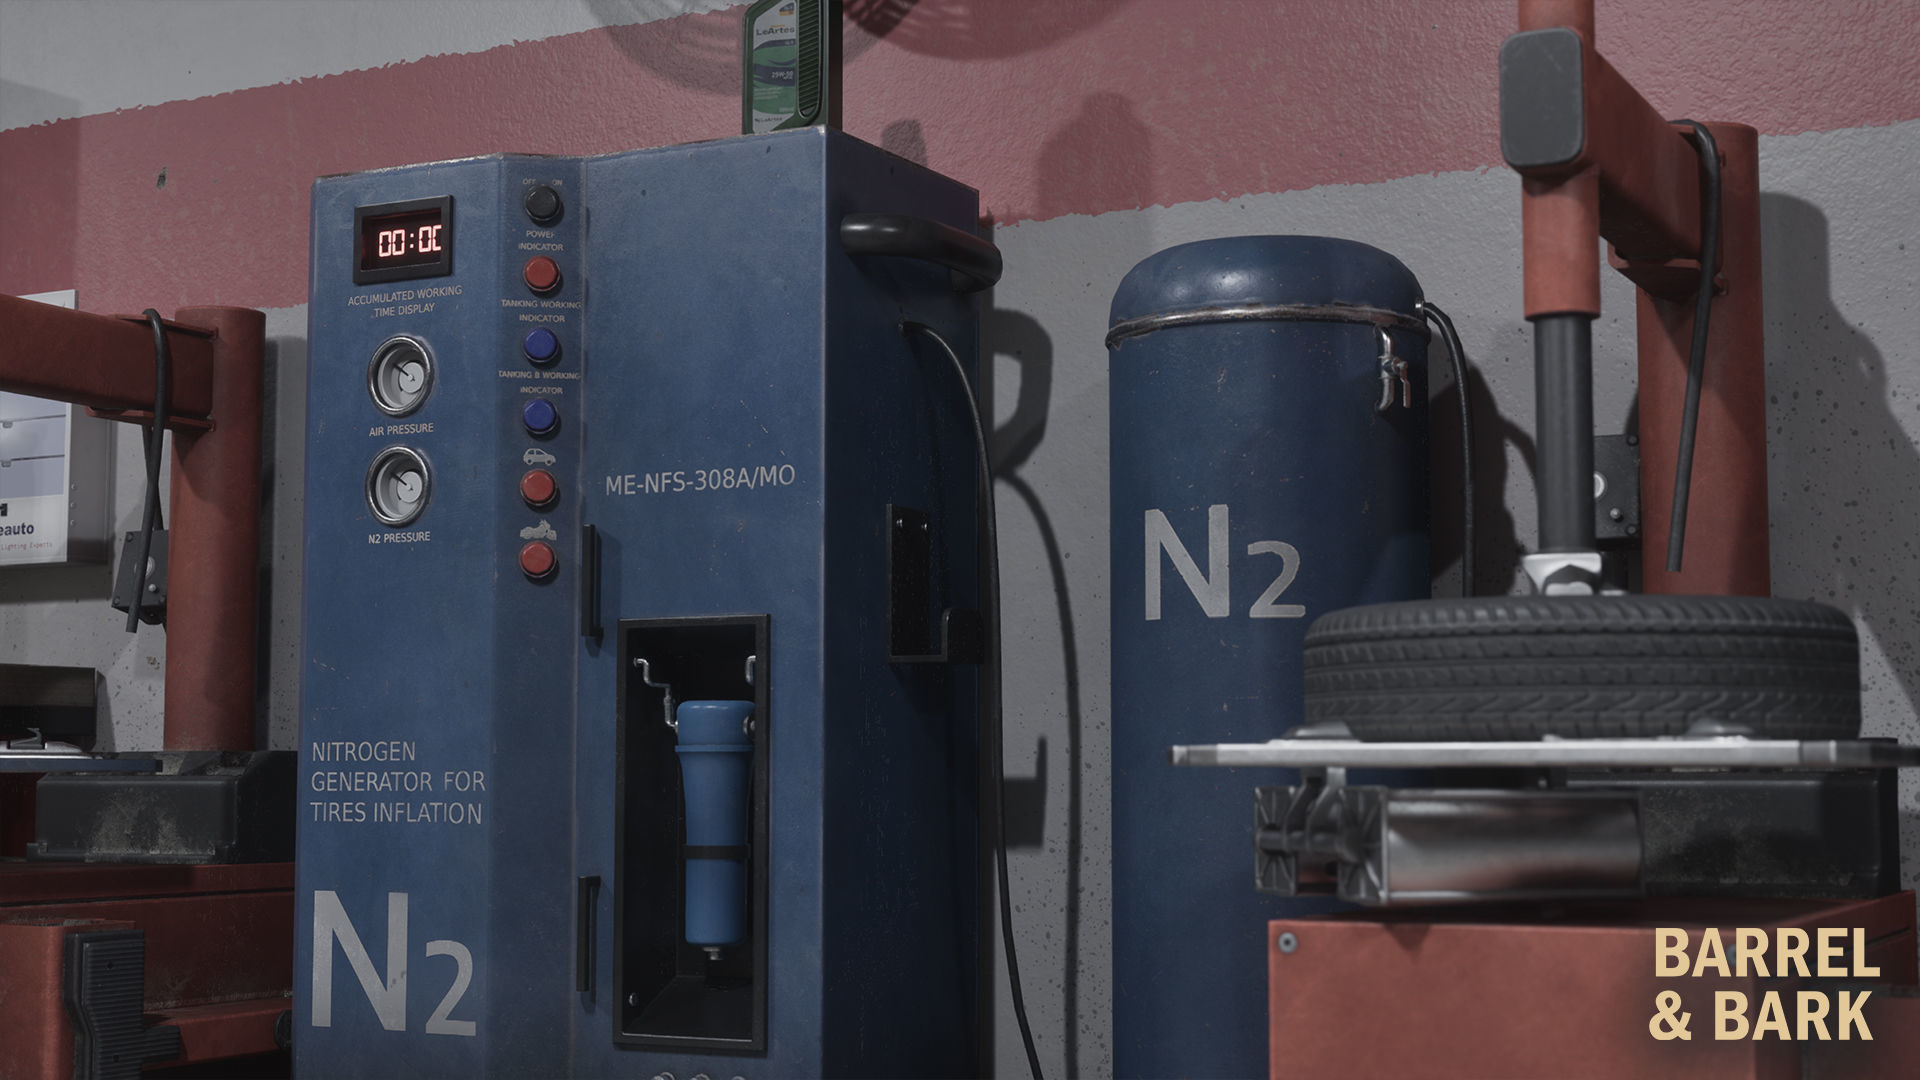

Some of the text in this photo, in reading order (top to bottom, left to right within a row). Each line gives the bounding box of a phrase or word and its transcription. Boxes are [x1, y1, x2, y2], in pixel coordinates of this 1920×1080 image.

[518, 242, 564, 251] INDICATOR
[348, 285, 462, 306] ACCUMULATED WORKING
[374, 303, 435, 317] TIME DISPLAY
[501, 299, 581, 309] TANKING WORKING
[519, 314, 565, 322] INDICATOR
[499, 370, 532, 379] TANKING
[520, 386, 563, 394] INDICATOR
[369, 423, 434, 437] AIR PRESSURE
[606, 464, 795, 496] ME-NFS-308A/MO
[369, 531, 430, 544] N2 PRESSURE
[1145, 504, 1306, 620] N2
[312, 741, 416, 761] NITROGEN
[312, 770, 486, 791] GENERATOR FOR
[310, 802, 482, 824] TIRES INFLATION
[312, 890, 476, 1036] N2
